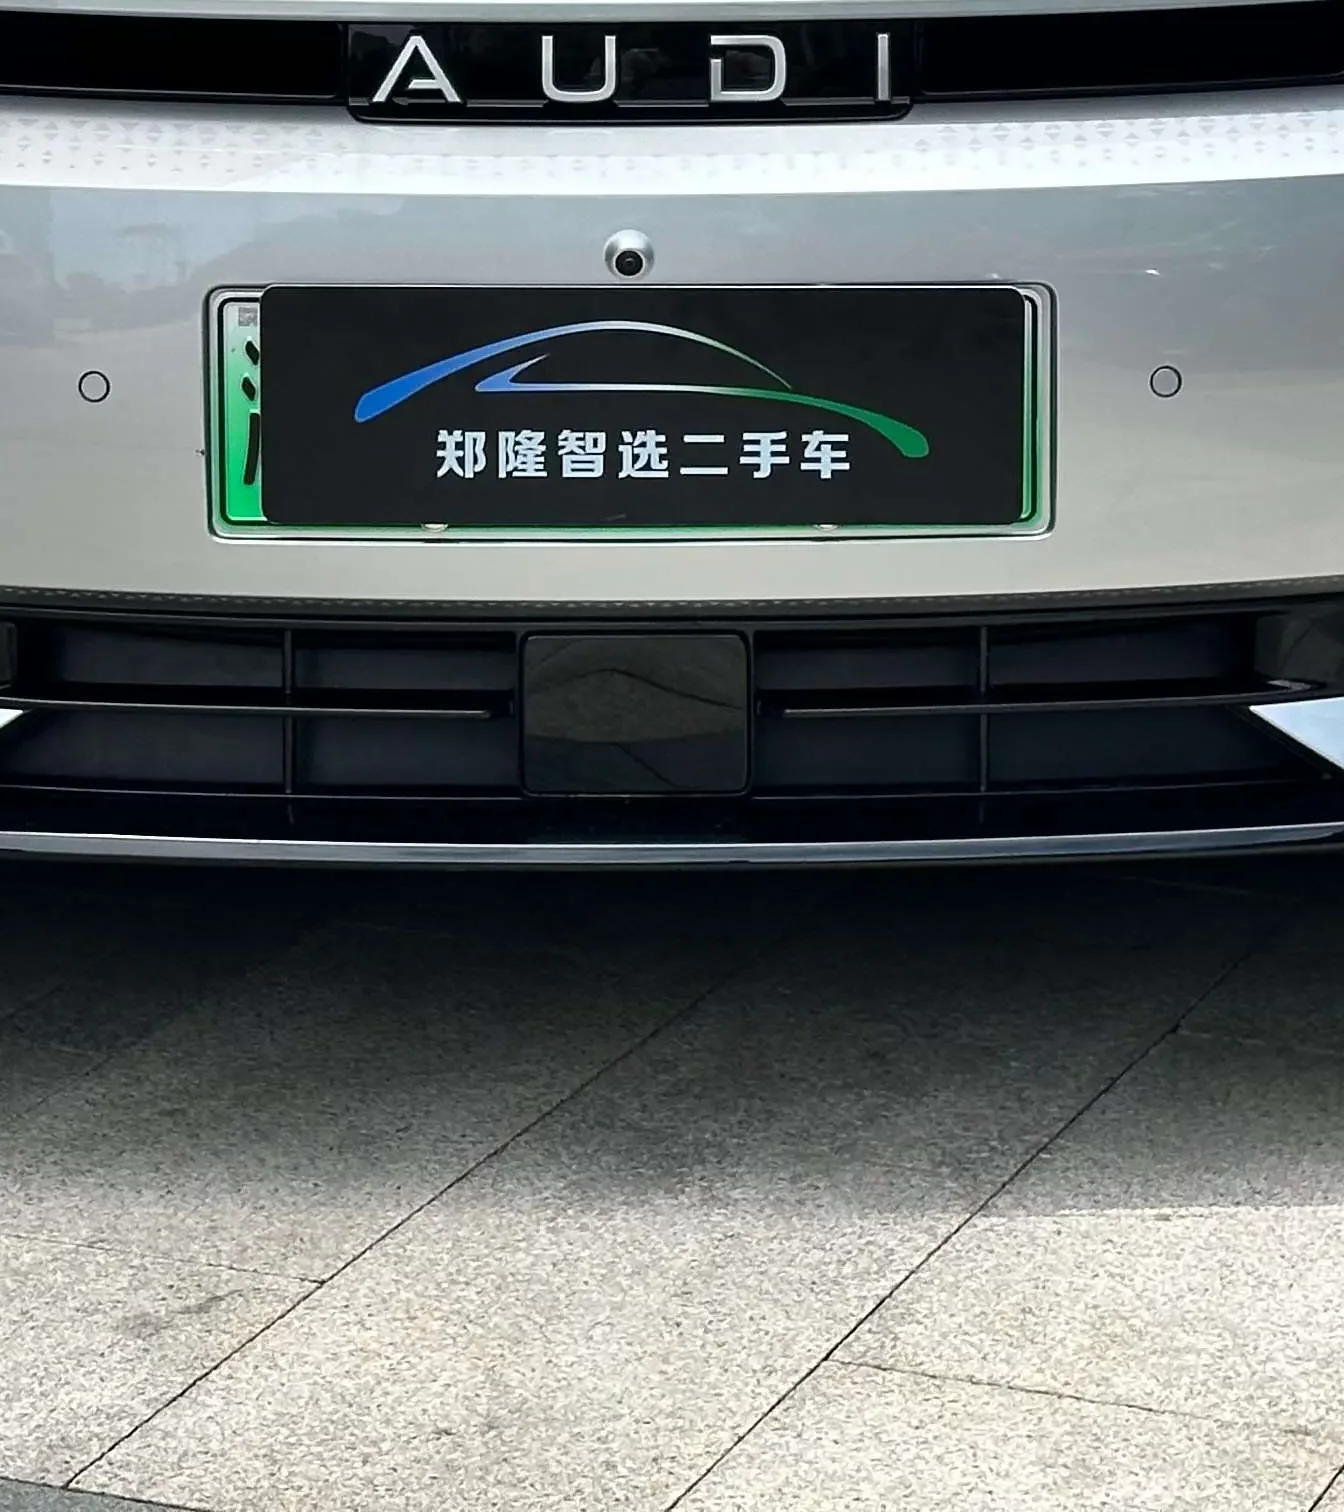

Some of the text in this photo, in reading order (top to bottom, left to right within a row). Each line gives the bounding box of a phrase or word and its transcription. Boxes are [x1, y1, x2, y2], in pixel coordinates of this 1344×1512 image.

[372, 33, 891, 103] AUDI
[436, 429, 851, 479] 郑隆智选二手车
